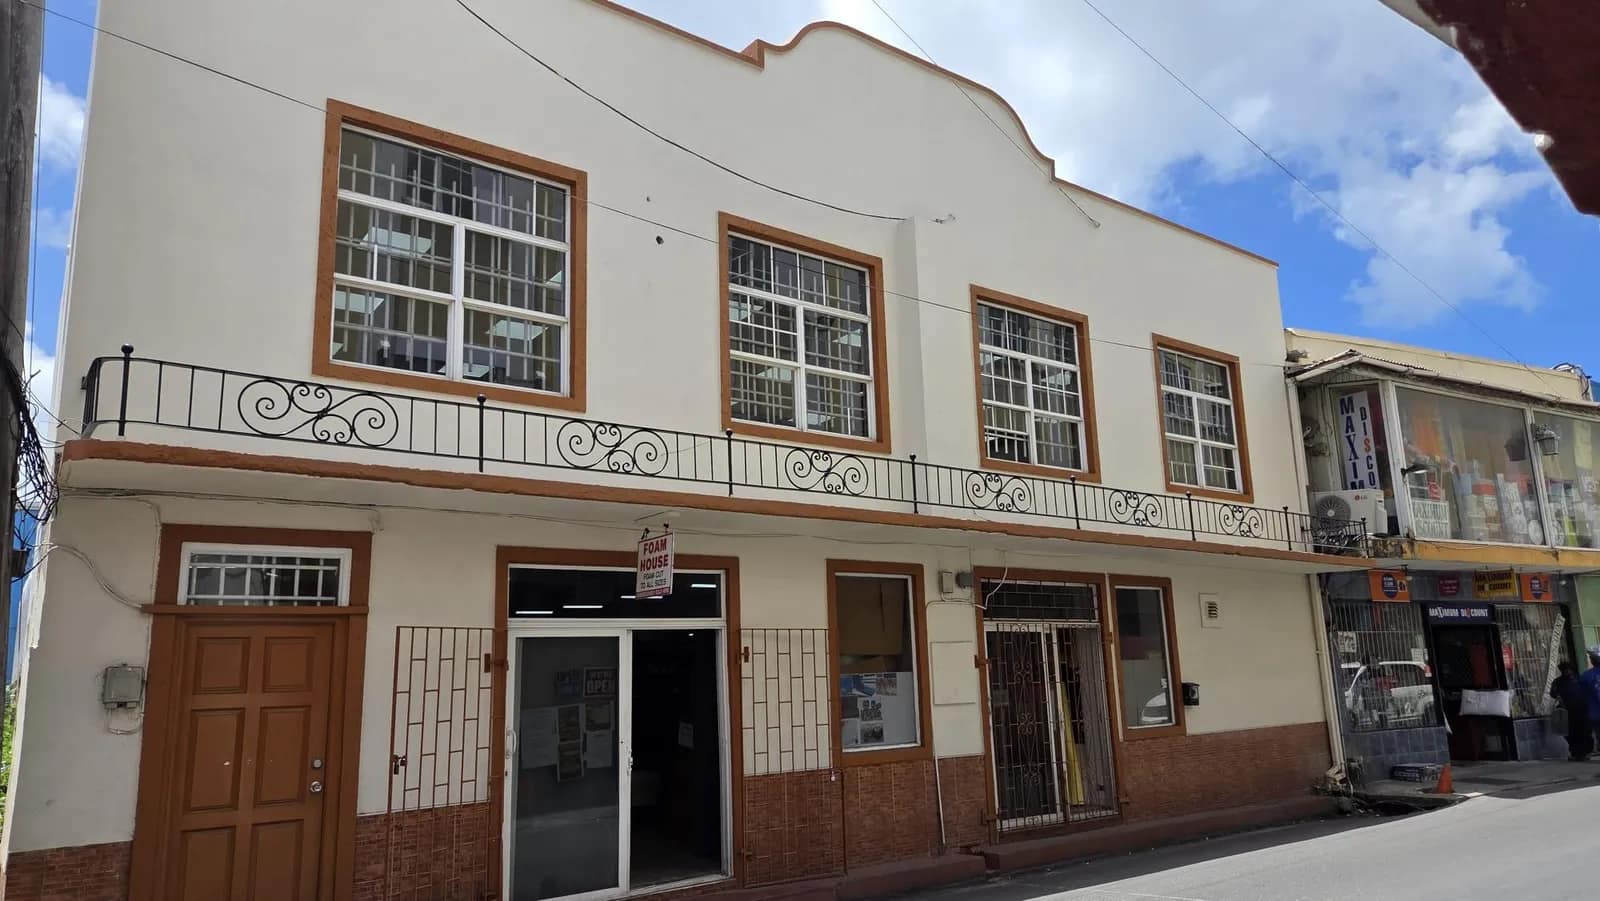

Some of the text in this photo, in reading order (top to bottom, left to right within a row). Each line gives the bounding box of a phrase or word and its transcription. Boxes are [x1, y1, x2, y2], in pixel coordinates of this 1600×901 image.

[1359, 406, 1377, 489] DISCO
[643, 538, 667, 555] FOAM
[640, 554, 669, 572] HOUSE
[655, 570, 664, 578] CUT
[1429, 606, 1488, 618] MAXIMUM DISCOUNT
[586, 679, 616, 694] OPEN
